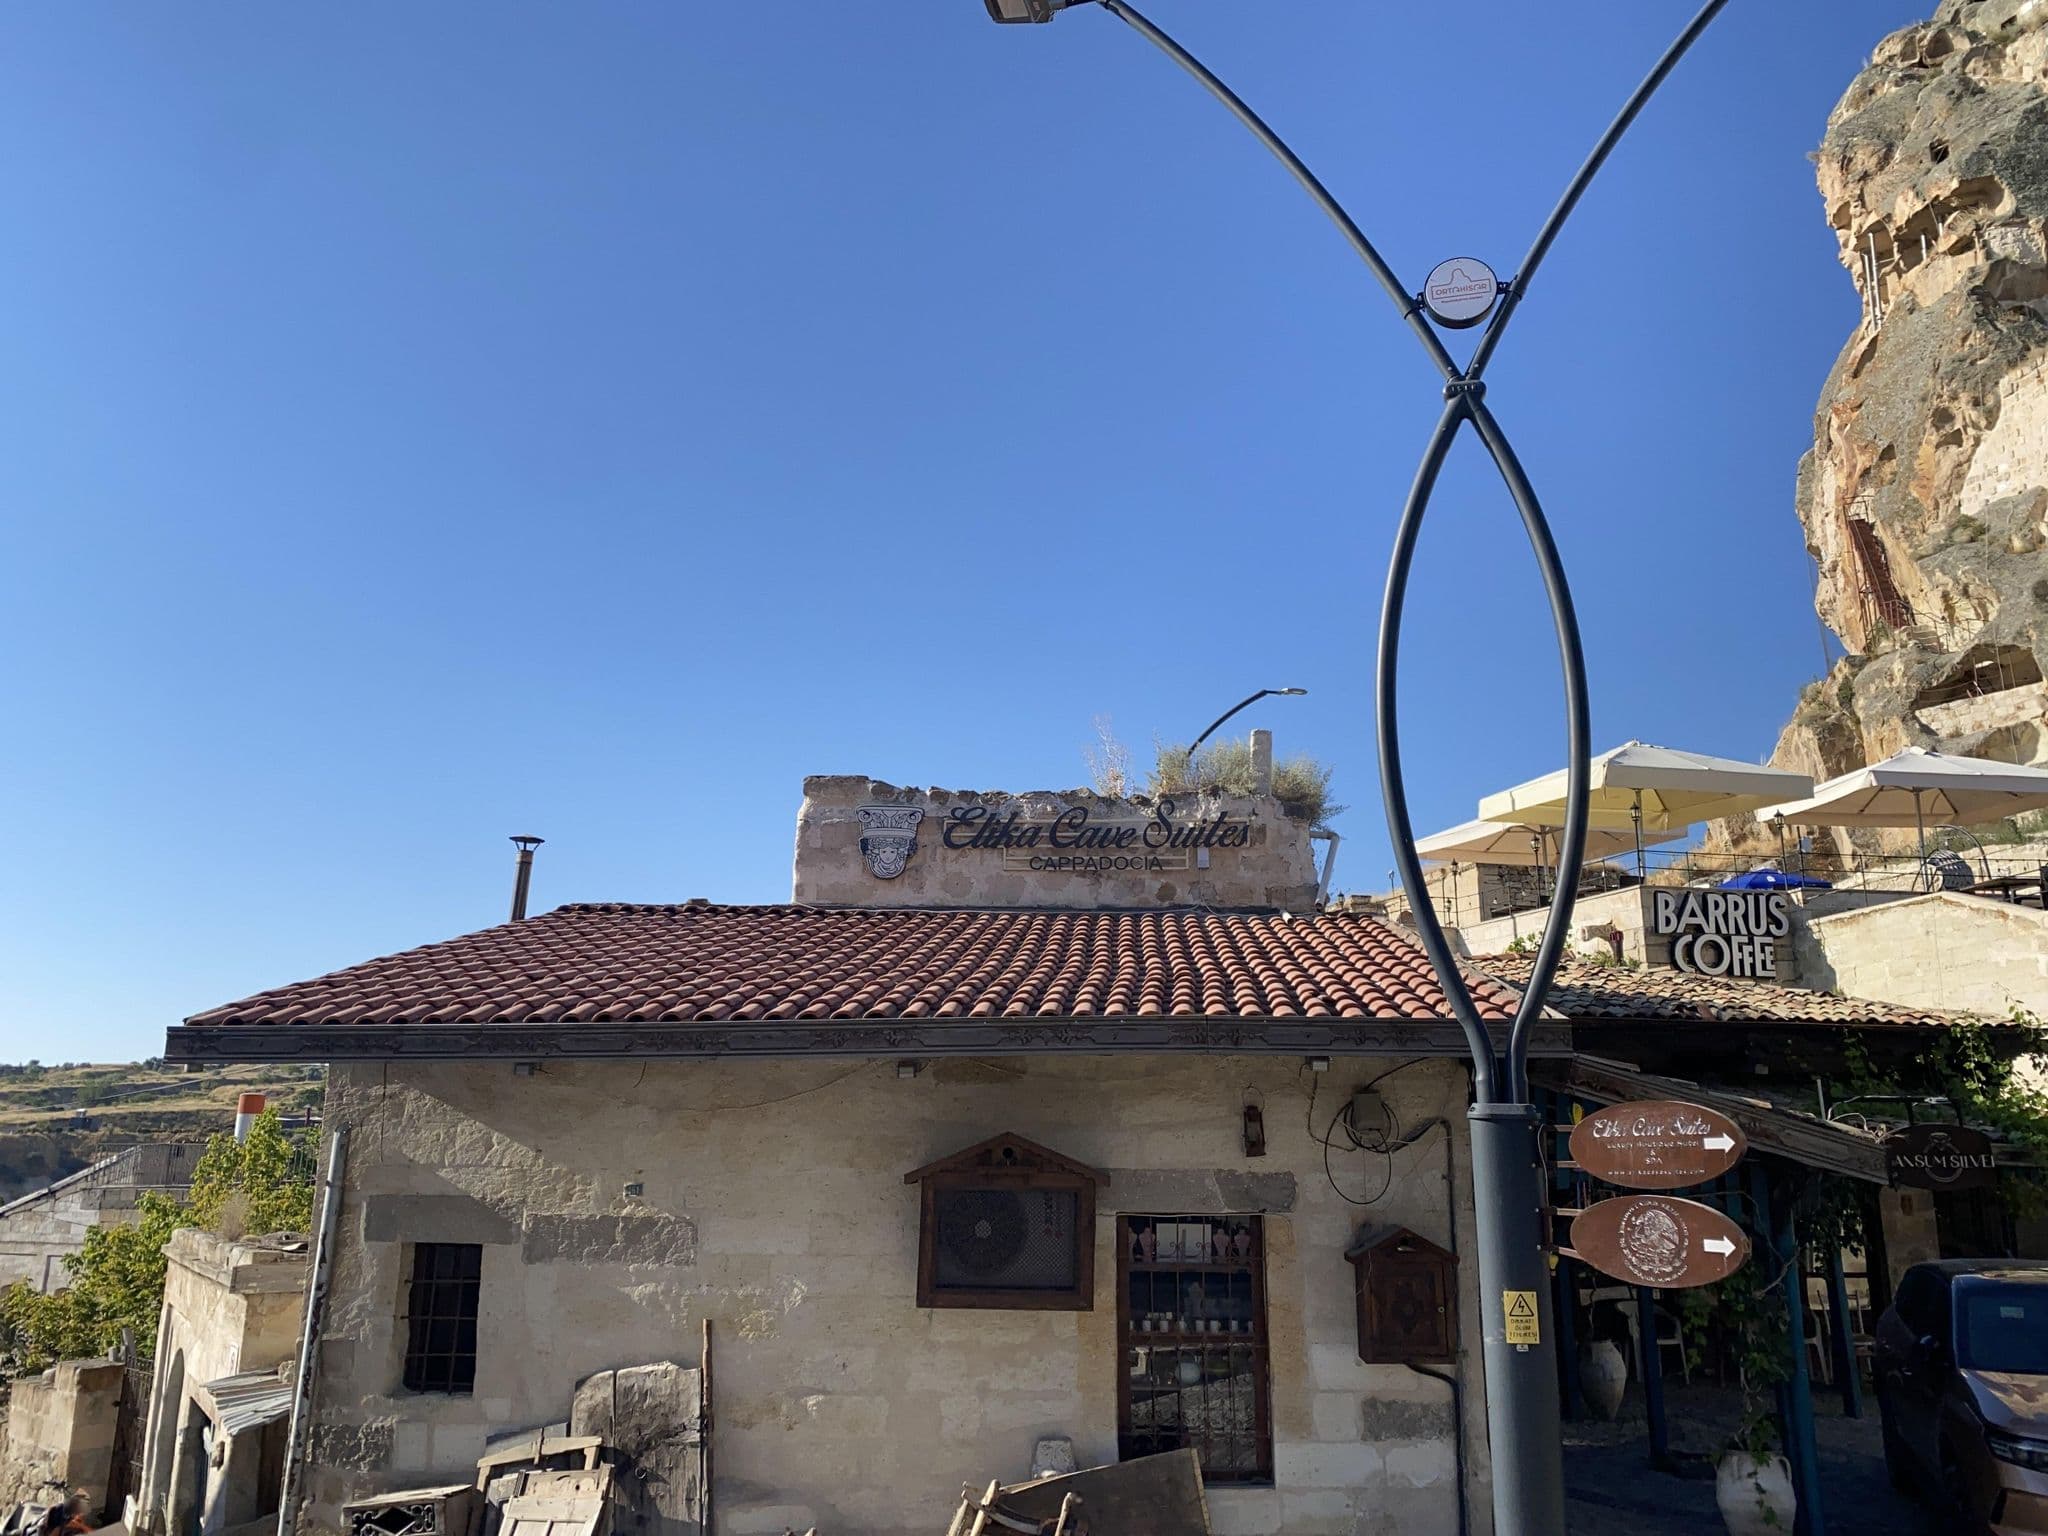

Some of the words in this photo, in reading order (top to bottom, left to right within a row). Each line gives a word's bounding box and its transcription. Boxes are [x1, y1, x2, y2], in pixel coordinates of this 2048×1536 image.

[943, 806, 1043, 849] Elika
[1049, 808, 1137, 849] Cave
[1142, 801, 1249, 849] Suites
[1029, 855, 1164, 872] CAPPADOCIA
[1655, 891, 1790, 937] BARRUS
[1673, 933, 1777, 978] COFFEE
[1670, 1116, 1711, 1136] Suites
